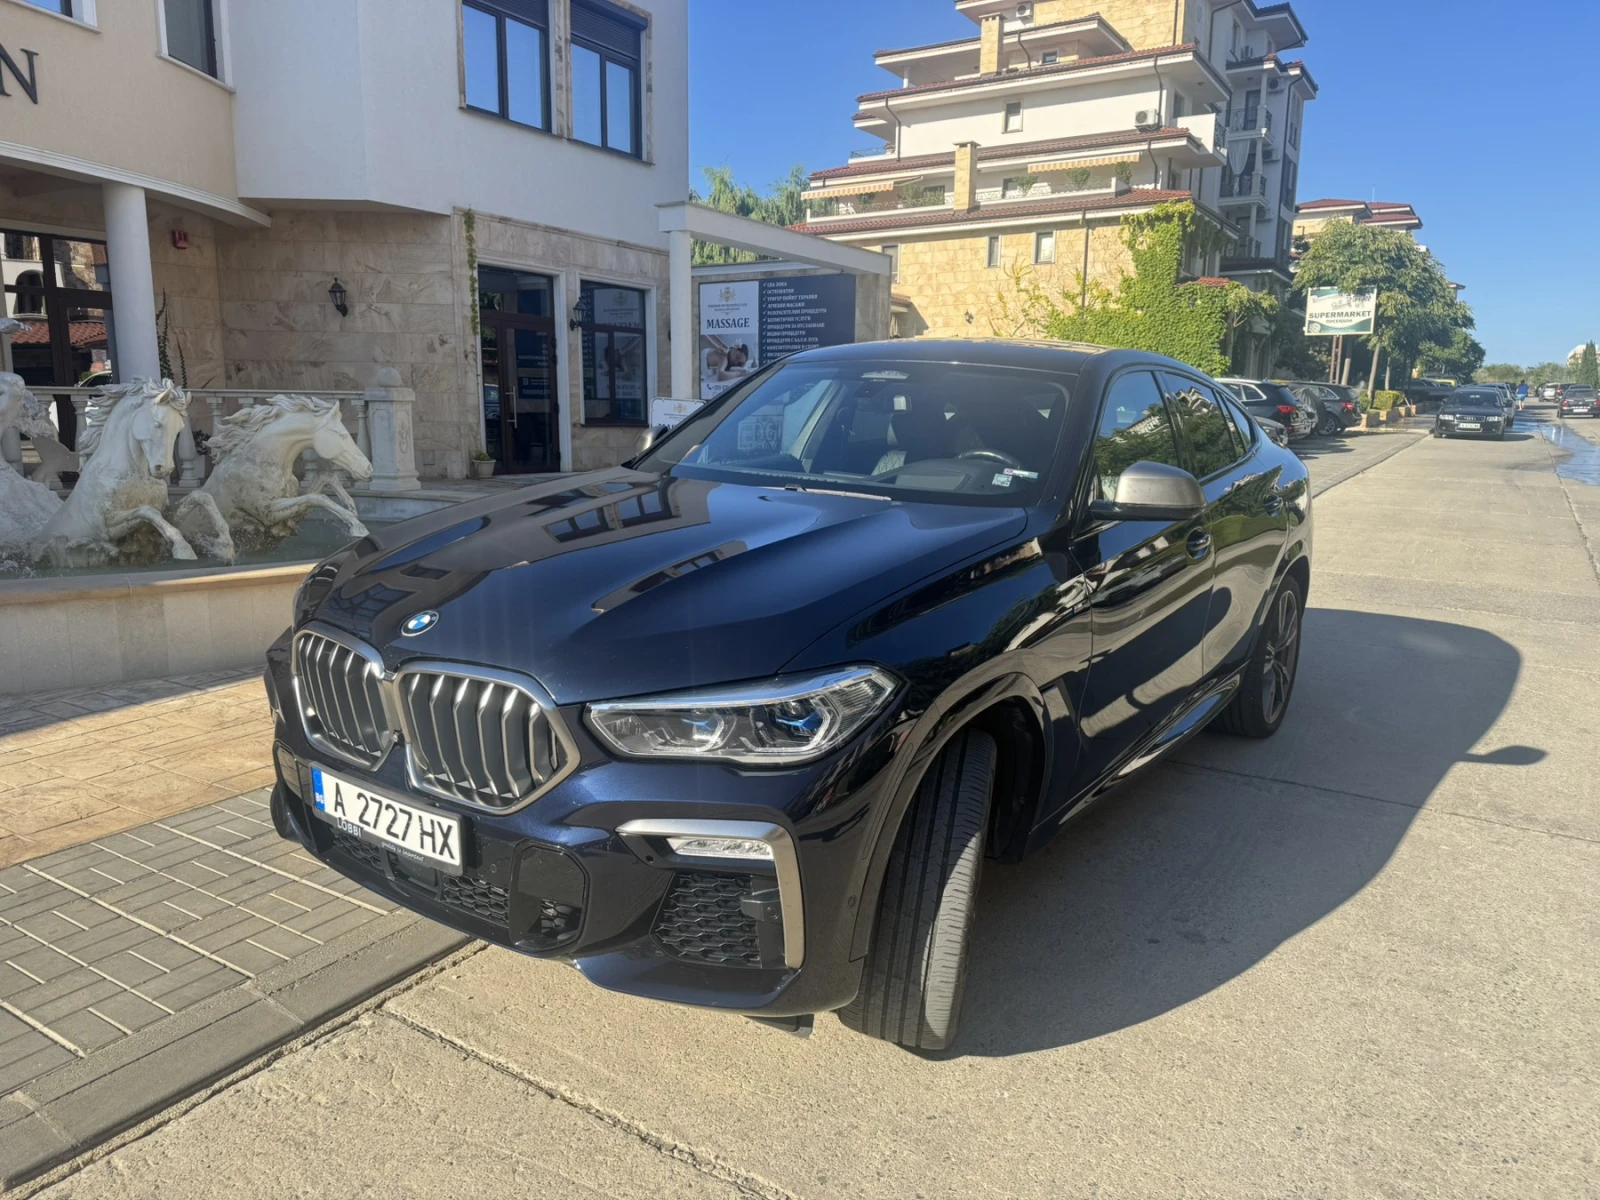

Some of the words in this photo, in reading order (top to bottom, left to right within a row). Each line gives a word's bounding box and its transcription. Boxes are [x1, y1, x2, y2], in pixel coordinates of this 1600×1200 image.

[706, 317, 750, 329] MASSAGE
[315, 791, 325, 805] BG
[334, 781, 347, 818] A
[356, 791, 413, 842] 2727
[418, 815, 455, 860] HX
